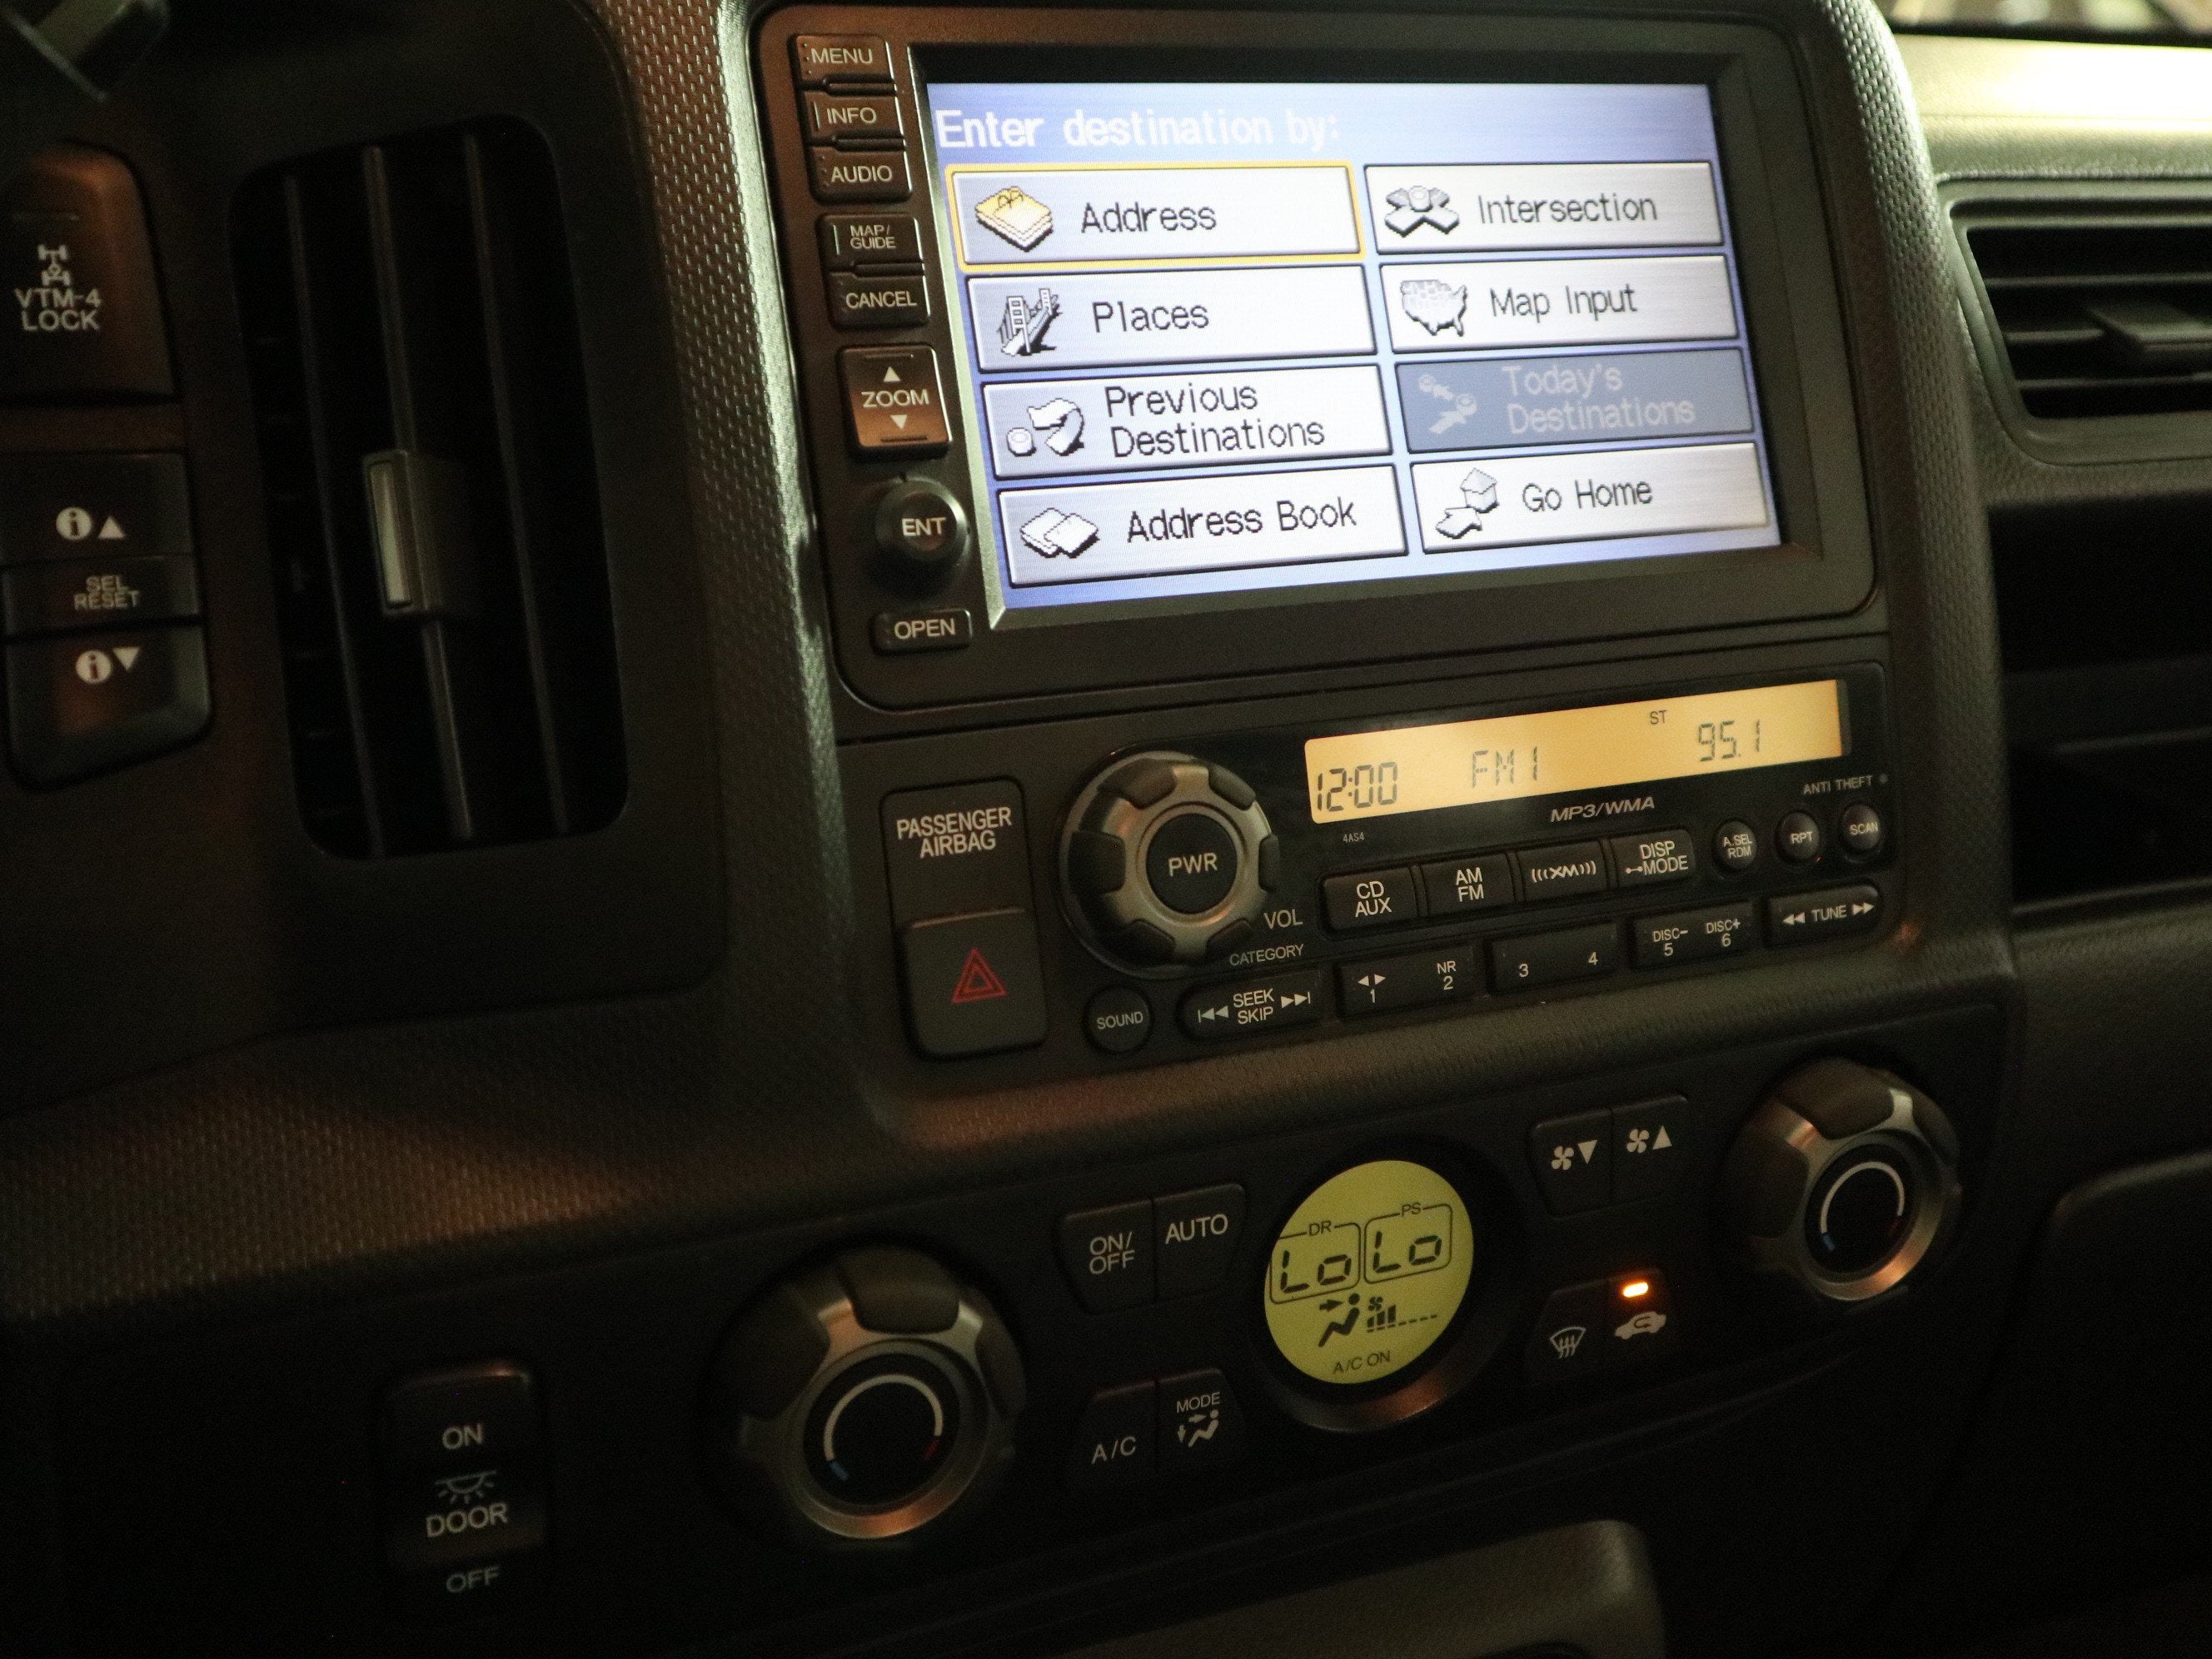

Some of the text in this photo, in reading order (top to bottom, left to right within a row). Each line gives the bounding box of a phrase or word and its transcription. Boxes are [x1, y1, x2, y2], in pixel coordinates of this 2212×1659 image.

[810, 48, 873, 64] MENU
[827, 107, 877, 123] INFO
[934, 108, 1339, 152] Enter destination by:
[831, 165, 893, 182] AUDIO
[1081, 201, 1218, 234] Address
[1477, 192, 1658, 223] Intersection
[849, 224, 890, 237] MAP/
[850, 237, 897, 249] GUIDE
[14, 287, 103, 308] VTM-4
[845, 291, 917, 310] CANCEL
[1490, 283, 1638, 323] Map Input
[22, 309, 100, 331] LOCK
[1092, 301, 1210, 333] Places
[1502, 363, 1623, 399] Today's
[861, 388, 930, 408] ZOOM
[1104, 382, 1258, 418] Previous
[1507, 397, 1696, 436] Destinations
[1111, 419, 1327, 458] Destinations
[1522, 478, 1654, 512] Go Home
[901, 516, 947, 537] ENT
[1127, 497, 1358, 544] Address Book
[86, 575, 129, 593] SEL
[74, 590, 141, 610] RESET
[894, 617, 957, 640] OPEN
[1649, 710, 1667, 725] ST
[1316, 761, 1398, 813] 12:00
[1802, 775, 1874, 795] ANTI THEFT
[1549, 796, 1656, 824] MP3/WMA
[896, 806, 1014, 840] PASSENGER
[1849, 822, 1880, 836] SCAN
[919, 830, 997, 859] AIRBAG
[1722, 834, 1753, 848] A.SEL
[1791, 831, 1814, 844] RPT
[1639, 840, 1676, 860] DISP
[1727, 844, 1752, 859] RDM
[1168, 852, 1218, 877] PWR
[1642, 854, 1689, 876] MODE
[1456, 867, 1483, 886] AM
[1356, 880, 1385, 900] CD
[1457, 884, 1484, 903] FM
[1354, 897, 1392, 918] AUX
[1811, 904, 1848, 922] TUNE
[1264, 909, 1303, 929] VOL
[1663, 942, 1674, 957] 5
[1720, 932, 1731, 948] 6
[1229, 944, 1304, 967] CATEGORY
[1587, 951, 1599, 965] 4
[1437, 960, 1457, 975] NR
[1518, 963, 1529, 978] 3
[1442, 975, 1454, 991] 2
[1233, 989, 1275, 1009] SEEK
[1369, 989, 1376, 1004] 1
[1096, 1011, 1143, 1030] SOUND
[1238, 1006, 1274, 1025] SKIP
[1400, 1202, 1422, 1218] PS
[1165, 1213, 1228, 1245] AUTO
[1308, 1220, 1333, 1237] DR
[1089, 1231, 1133, 1257] ON/
[1089, 1249, 1135, 1275] OFF
[1333, 1350, 1392, 1374] A/C ON
[1176, 1392, 1222, 1414] MODE
[441, 1423, 484, 1451] ON
[1091, 1435, 1138, 1465] A/C
[426, 1502, 508, 1537] DOOR
[446, 1566, 500, 1594] OFF
